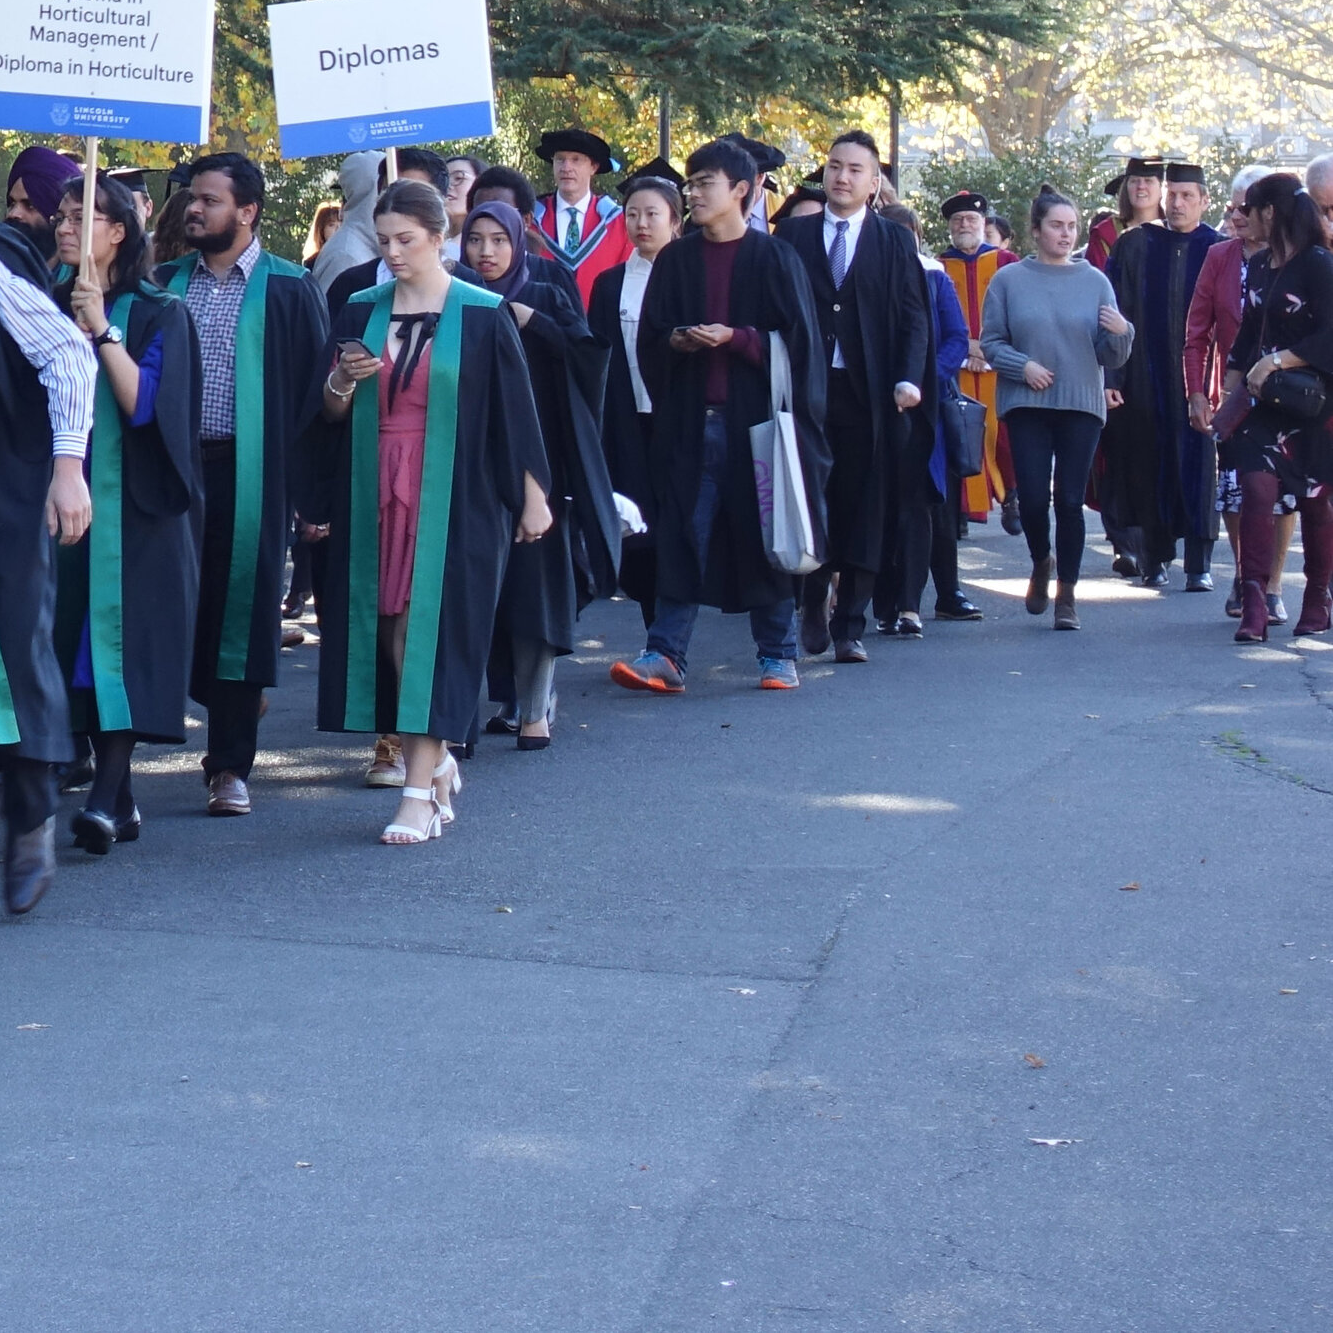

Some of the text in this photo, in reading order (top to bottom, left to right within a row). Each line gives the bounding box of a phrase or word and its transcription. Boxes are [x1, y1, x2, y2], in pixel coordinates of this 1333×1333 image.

[39, 4, 151, 27] Horticultural
[29, 25, 146, 49] Management
[319, 42, 440, 73] Diplomas
[68, 58, 83, 75] in
[89, 60, 194, 83] Horticulture
[74, 106, 114, 116] LINCOLN
[74, 113, 131, 124] UNIVERSITY
[369, 119, 408, 129] LINCOLN
[370, 123, 424, 136] UNIVERSITY
